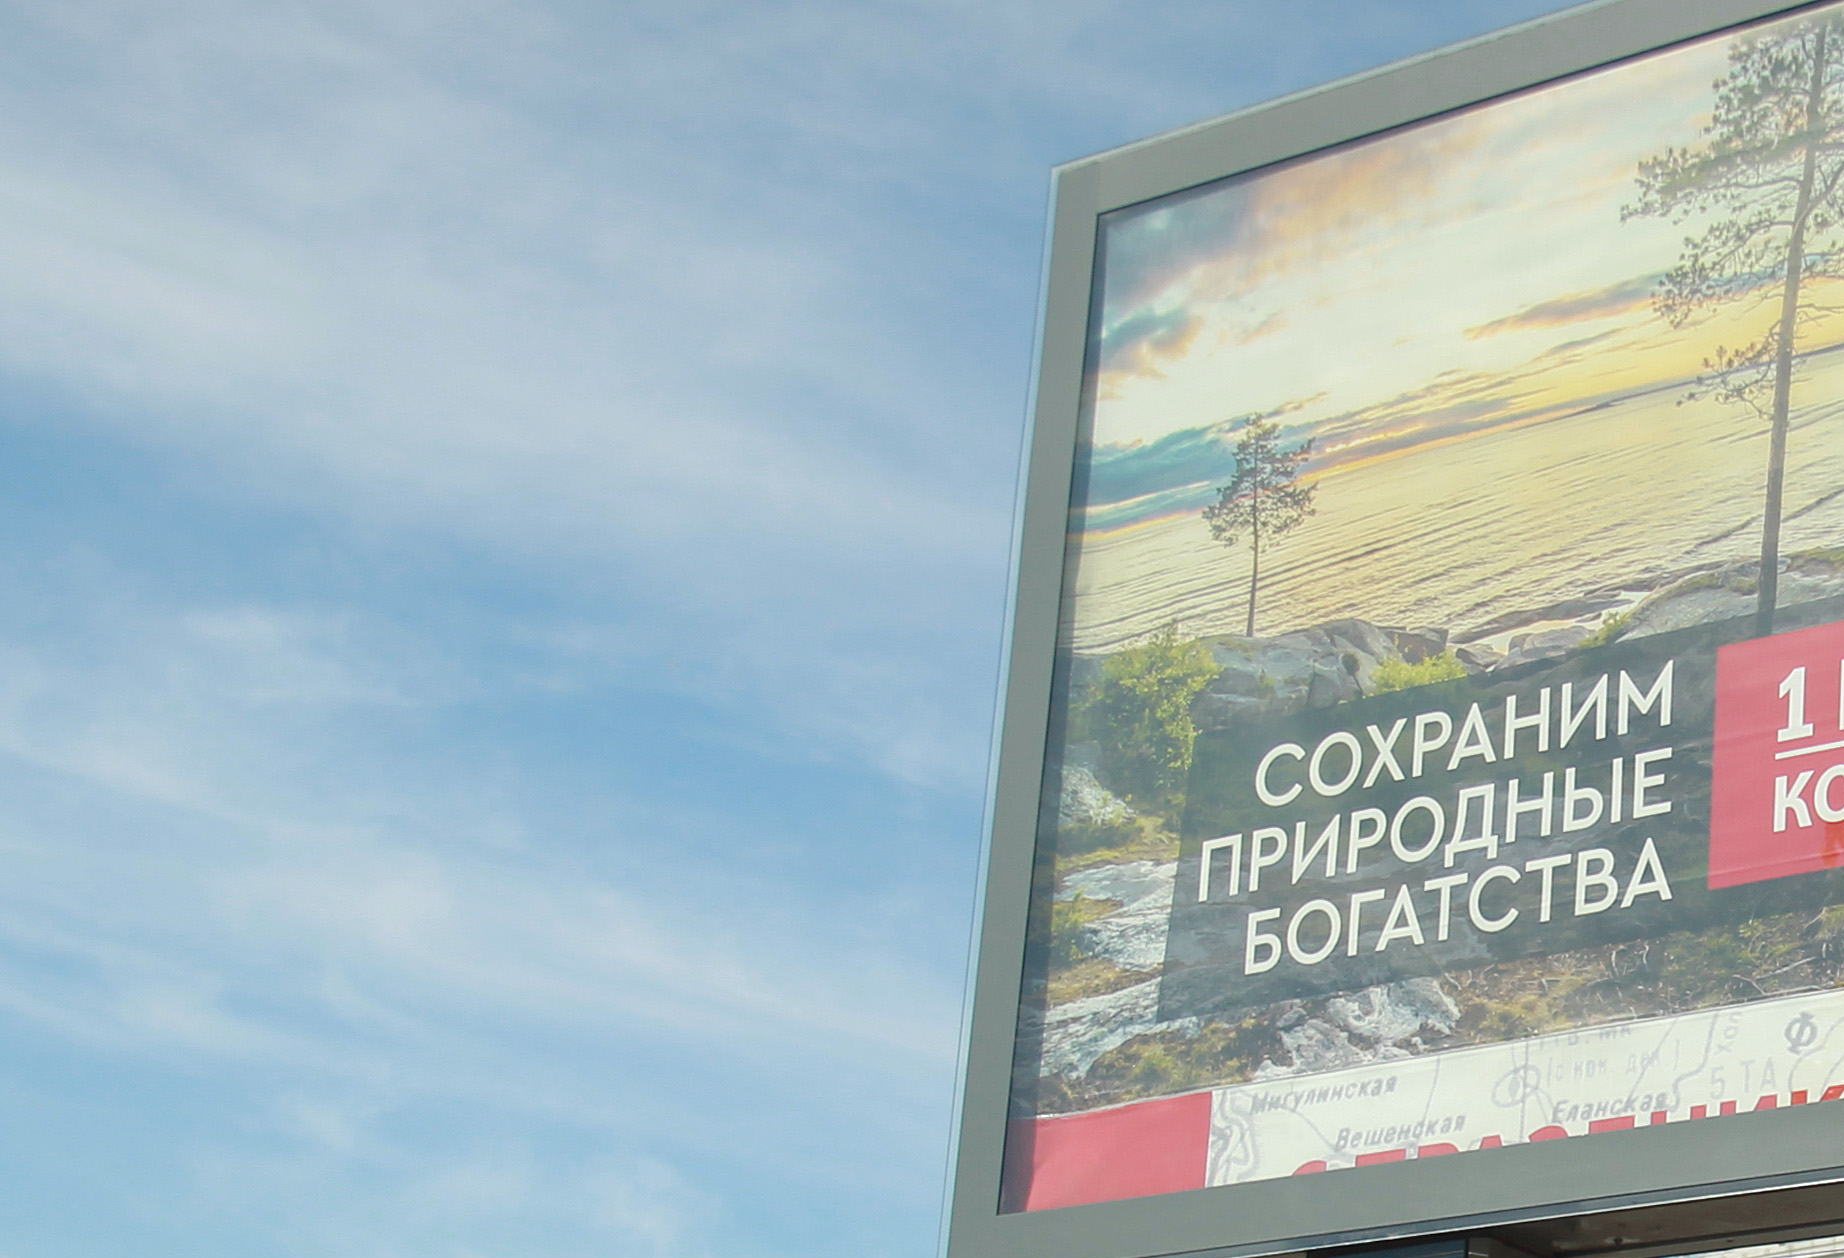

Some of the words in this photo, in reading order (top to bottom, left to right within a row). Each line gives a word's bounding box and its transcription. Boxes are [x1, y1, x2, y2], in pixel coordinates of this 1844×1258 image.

[1253, 658, 1674, 807] СОХРАНИМ
[1777, 666, 1814, 743] 1
[1198, 746, 1674, 903] ПРИРОДНЫЕ
[1243, 836, 1674, 977] БОГАТСТВА
[1335, 1113, 1467, 1151] Вешенская
